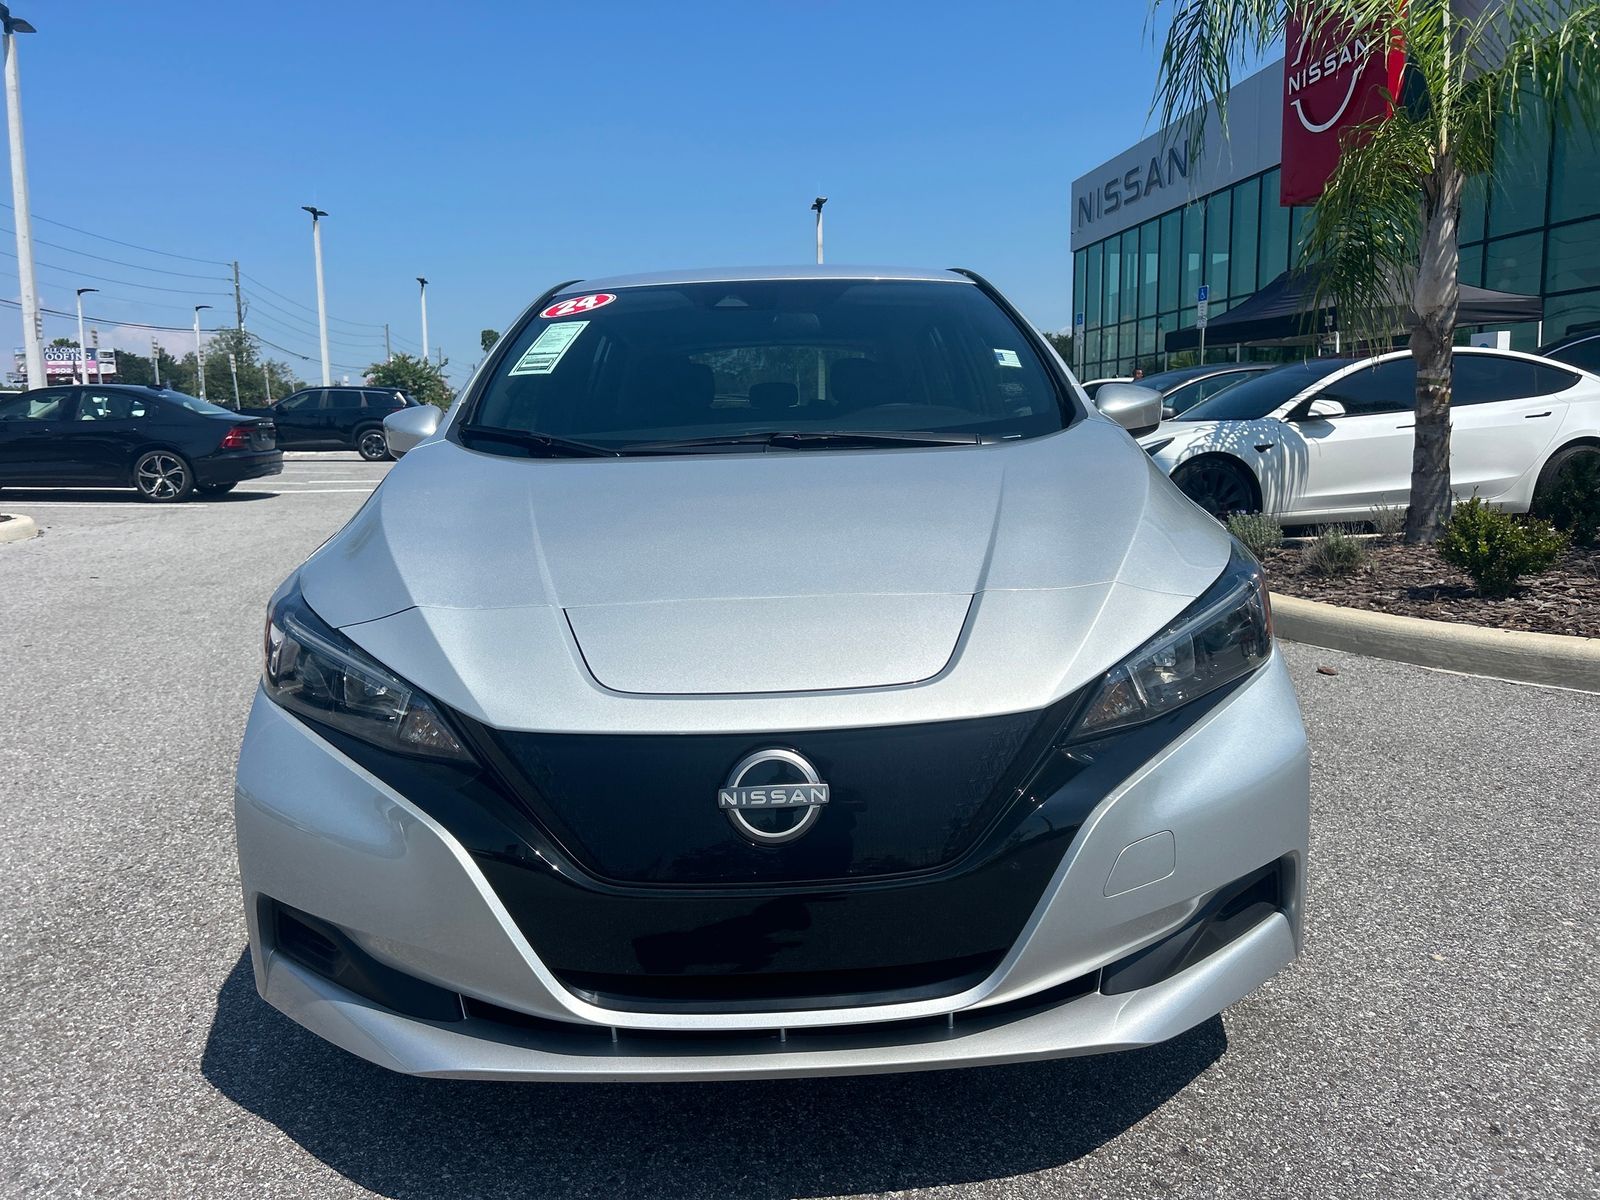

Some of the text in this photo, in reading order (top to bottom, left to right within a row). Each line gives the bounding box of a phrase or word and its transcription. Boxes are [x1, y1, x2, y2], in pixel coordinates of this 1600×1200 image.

[1288, 33, 1370, 95] NISSAN
[1078, 139, 1189, 228] NISSAN
[556, 295, 598, 315] 24
[45, 353, 92, 361] OOFING
[721, 787, 827, 806] NISSAN
